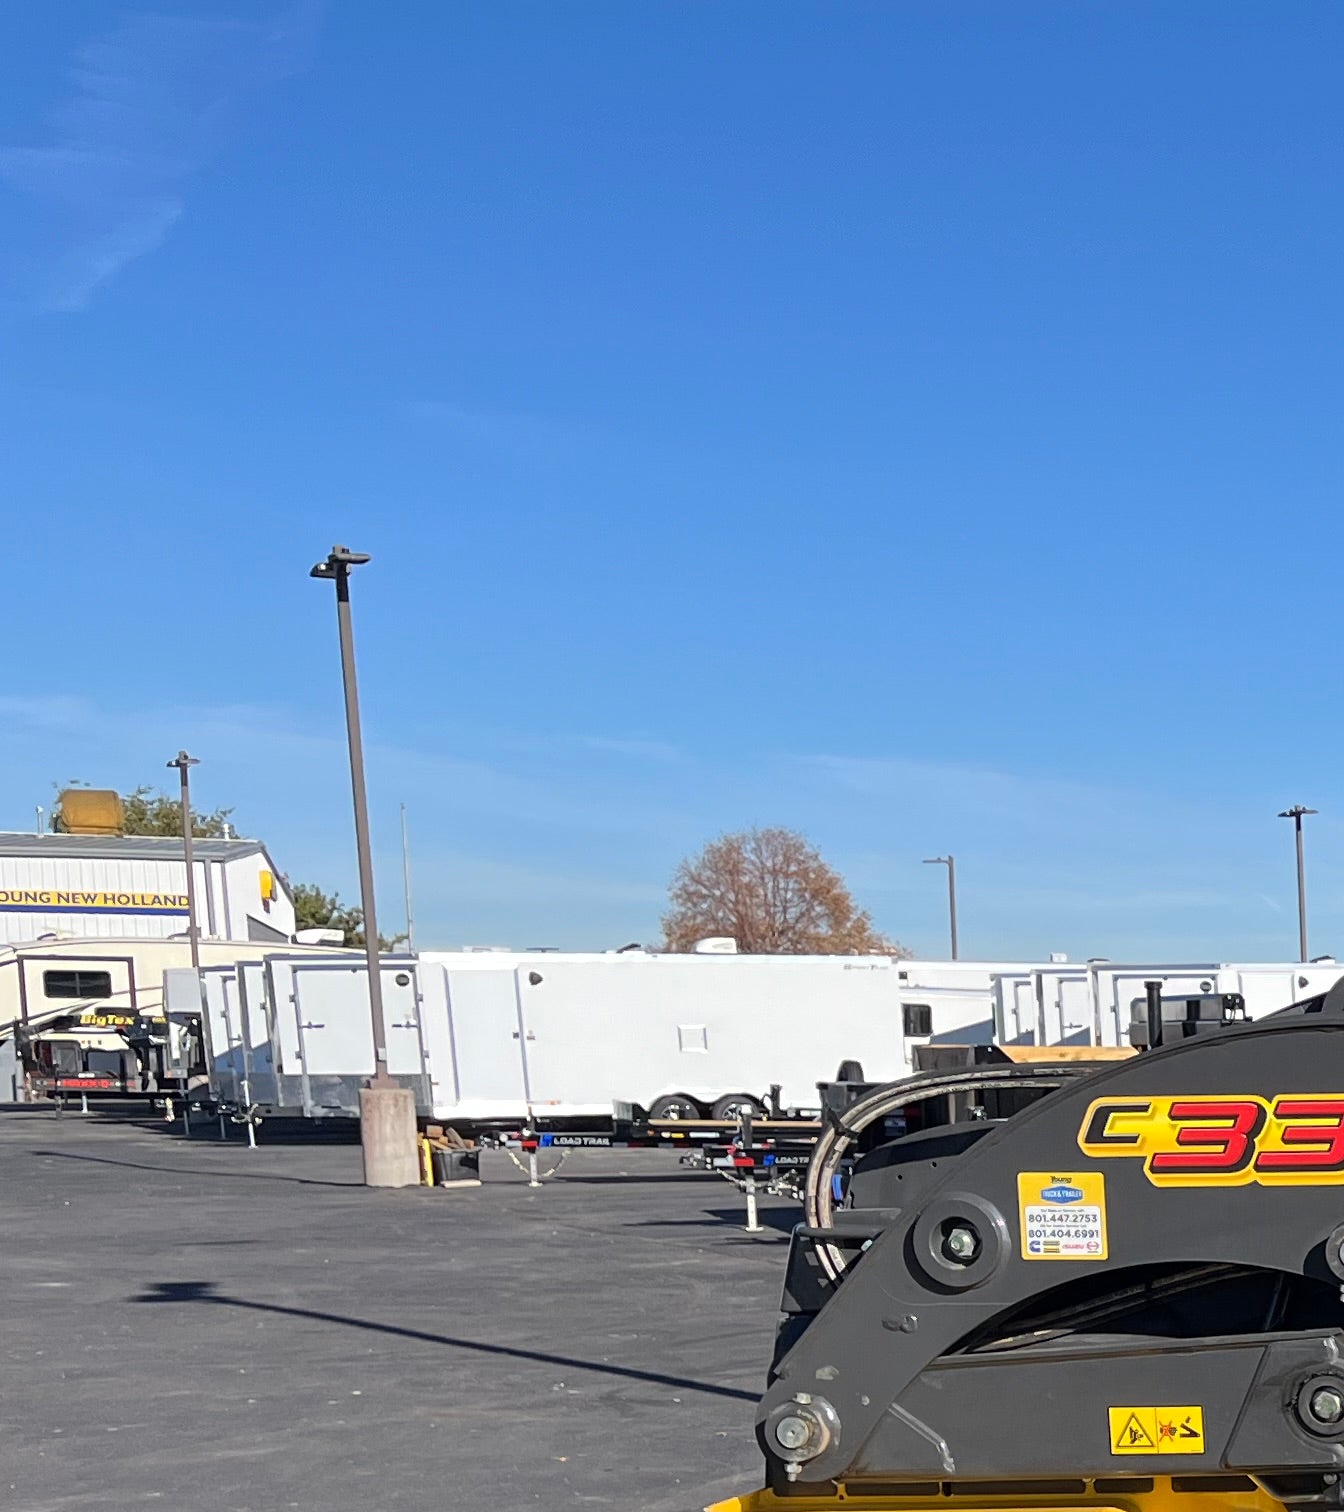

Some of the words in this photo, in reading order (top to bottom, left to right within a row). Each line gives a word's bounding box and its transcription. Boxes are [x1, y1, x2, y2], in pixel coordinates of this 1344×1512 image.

[0, 891, 51, 904] OUNG
[57, 891, 98, 905] NEW
[104, 893, 190, 907] HOLLAND
[553, 1137, 581, 1146] LOAD
[583, 1137, 611, 1146] TRAIL
[1028, 1214, 1098, 1223] 801.447.2753
[1028, 1229, 1099, 1239] 801.404.6991
